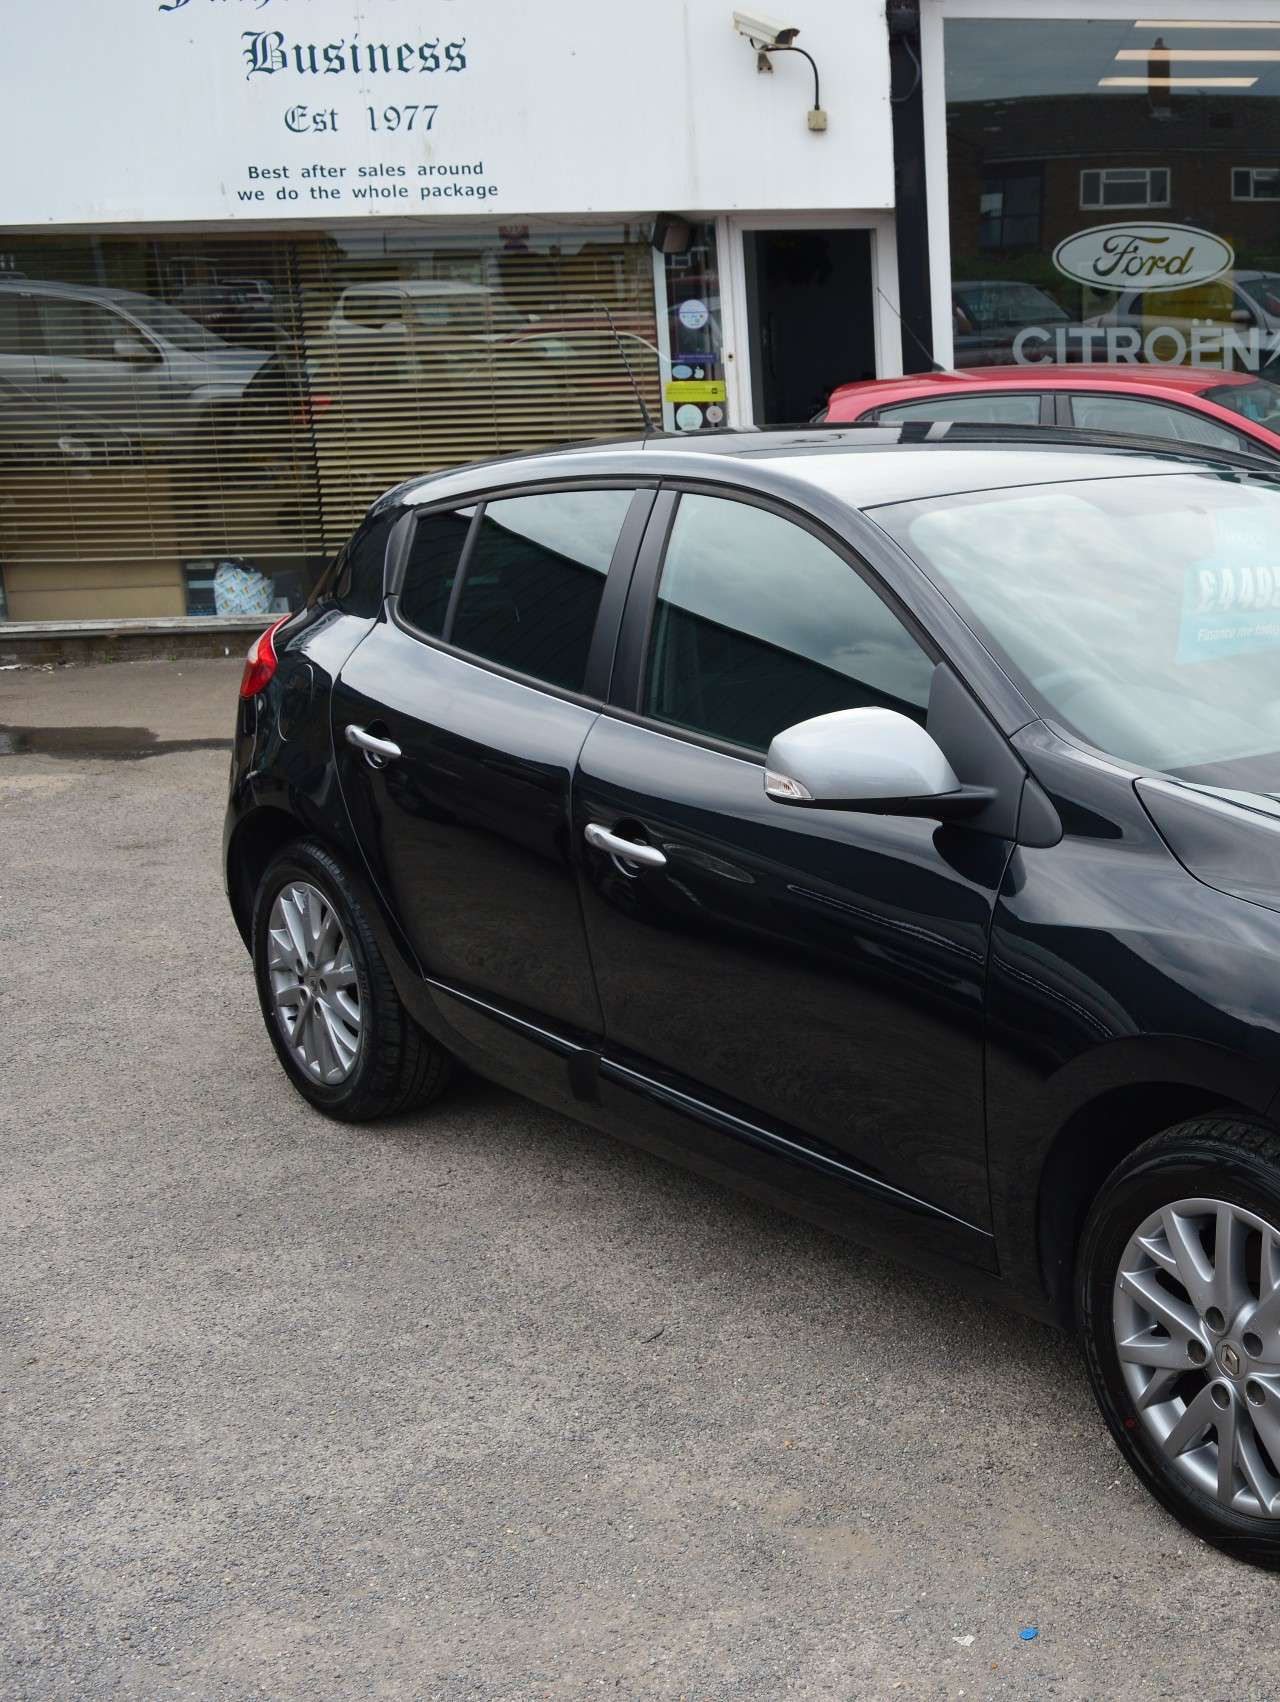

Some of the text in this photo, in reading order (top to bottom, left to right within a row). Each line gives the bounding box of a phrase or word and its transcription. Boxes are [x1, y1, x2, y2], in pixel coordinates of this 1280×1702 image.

[241, 31, 466, 81] Business
[284, 105, 439, 133] Est 1977
[248, 162, 484, 180] Best after sales around
[237, 183, 499, 201] we do the whole package
[1093, 234, 1195, 276] Ford
[1012, 320, 1260, 369] CITROËN
